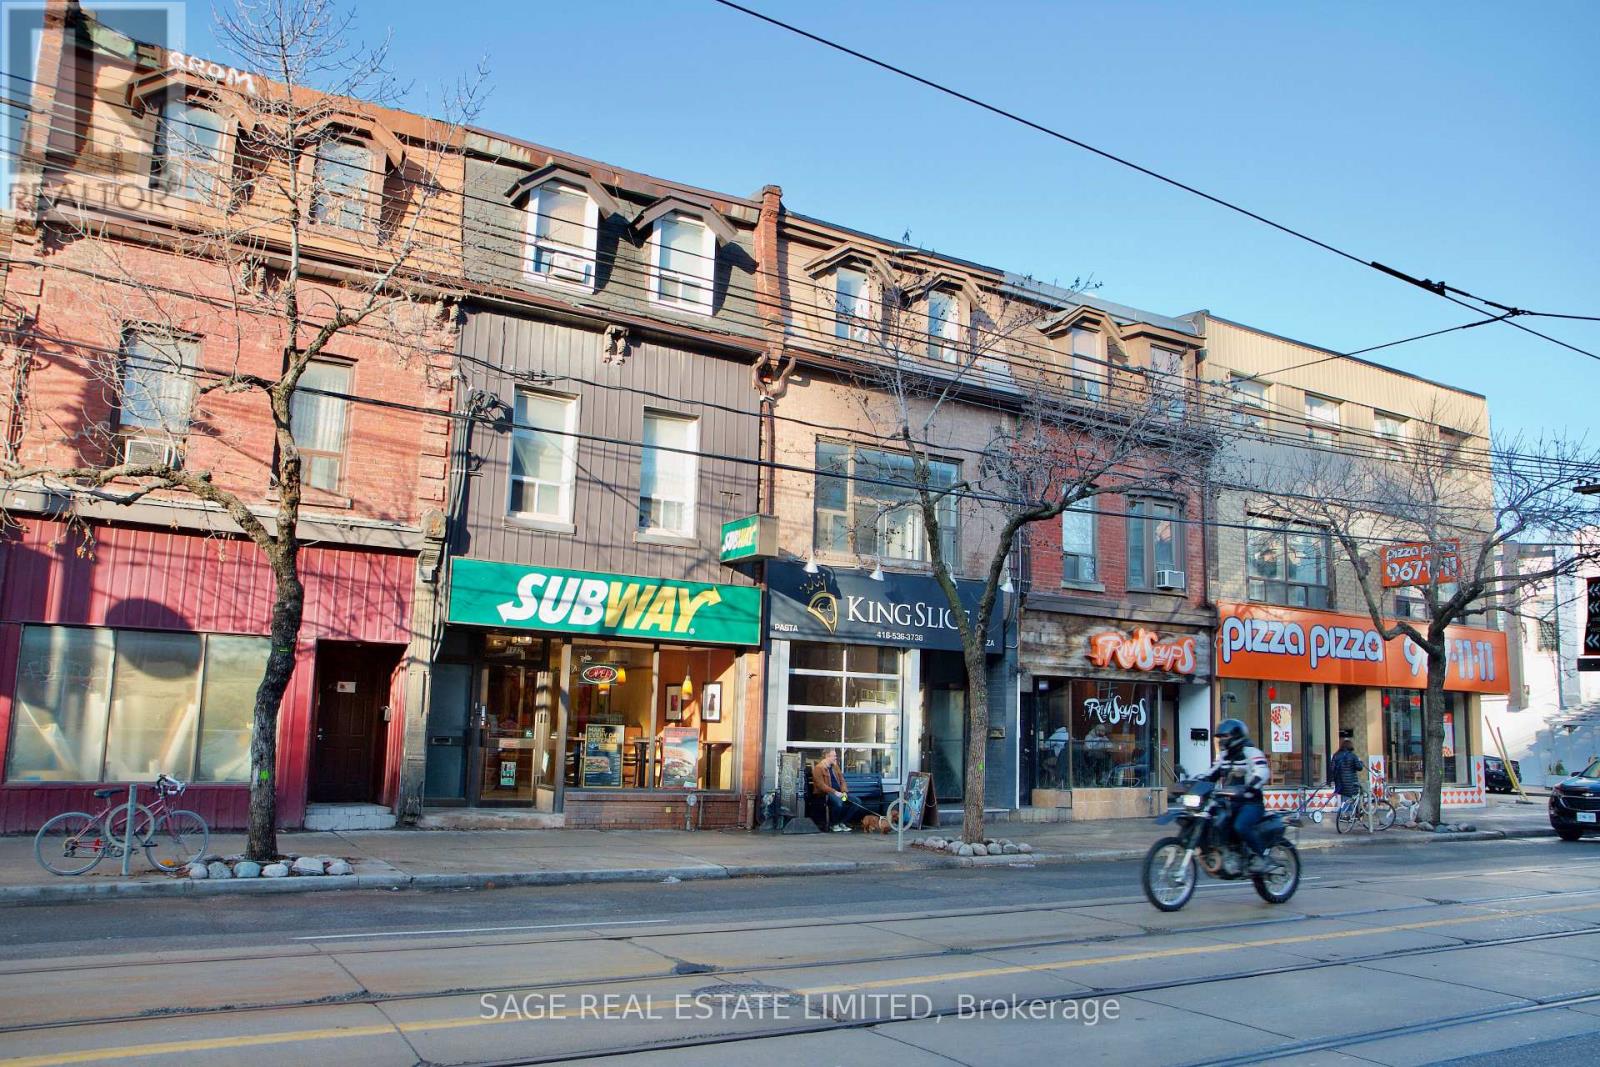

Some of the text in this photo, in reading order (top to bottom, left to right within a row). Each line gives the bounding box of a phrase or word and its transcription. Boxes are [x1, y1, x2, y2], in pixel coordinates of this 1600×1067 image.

[723, 525, 757, 552] SUBWAY
[497, 573, 721, 633] SUBWAY
[1222, 616, 1384, 670] pizza pizza
